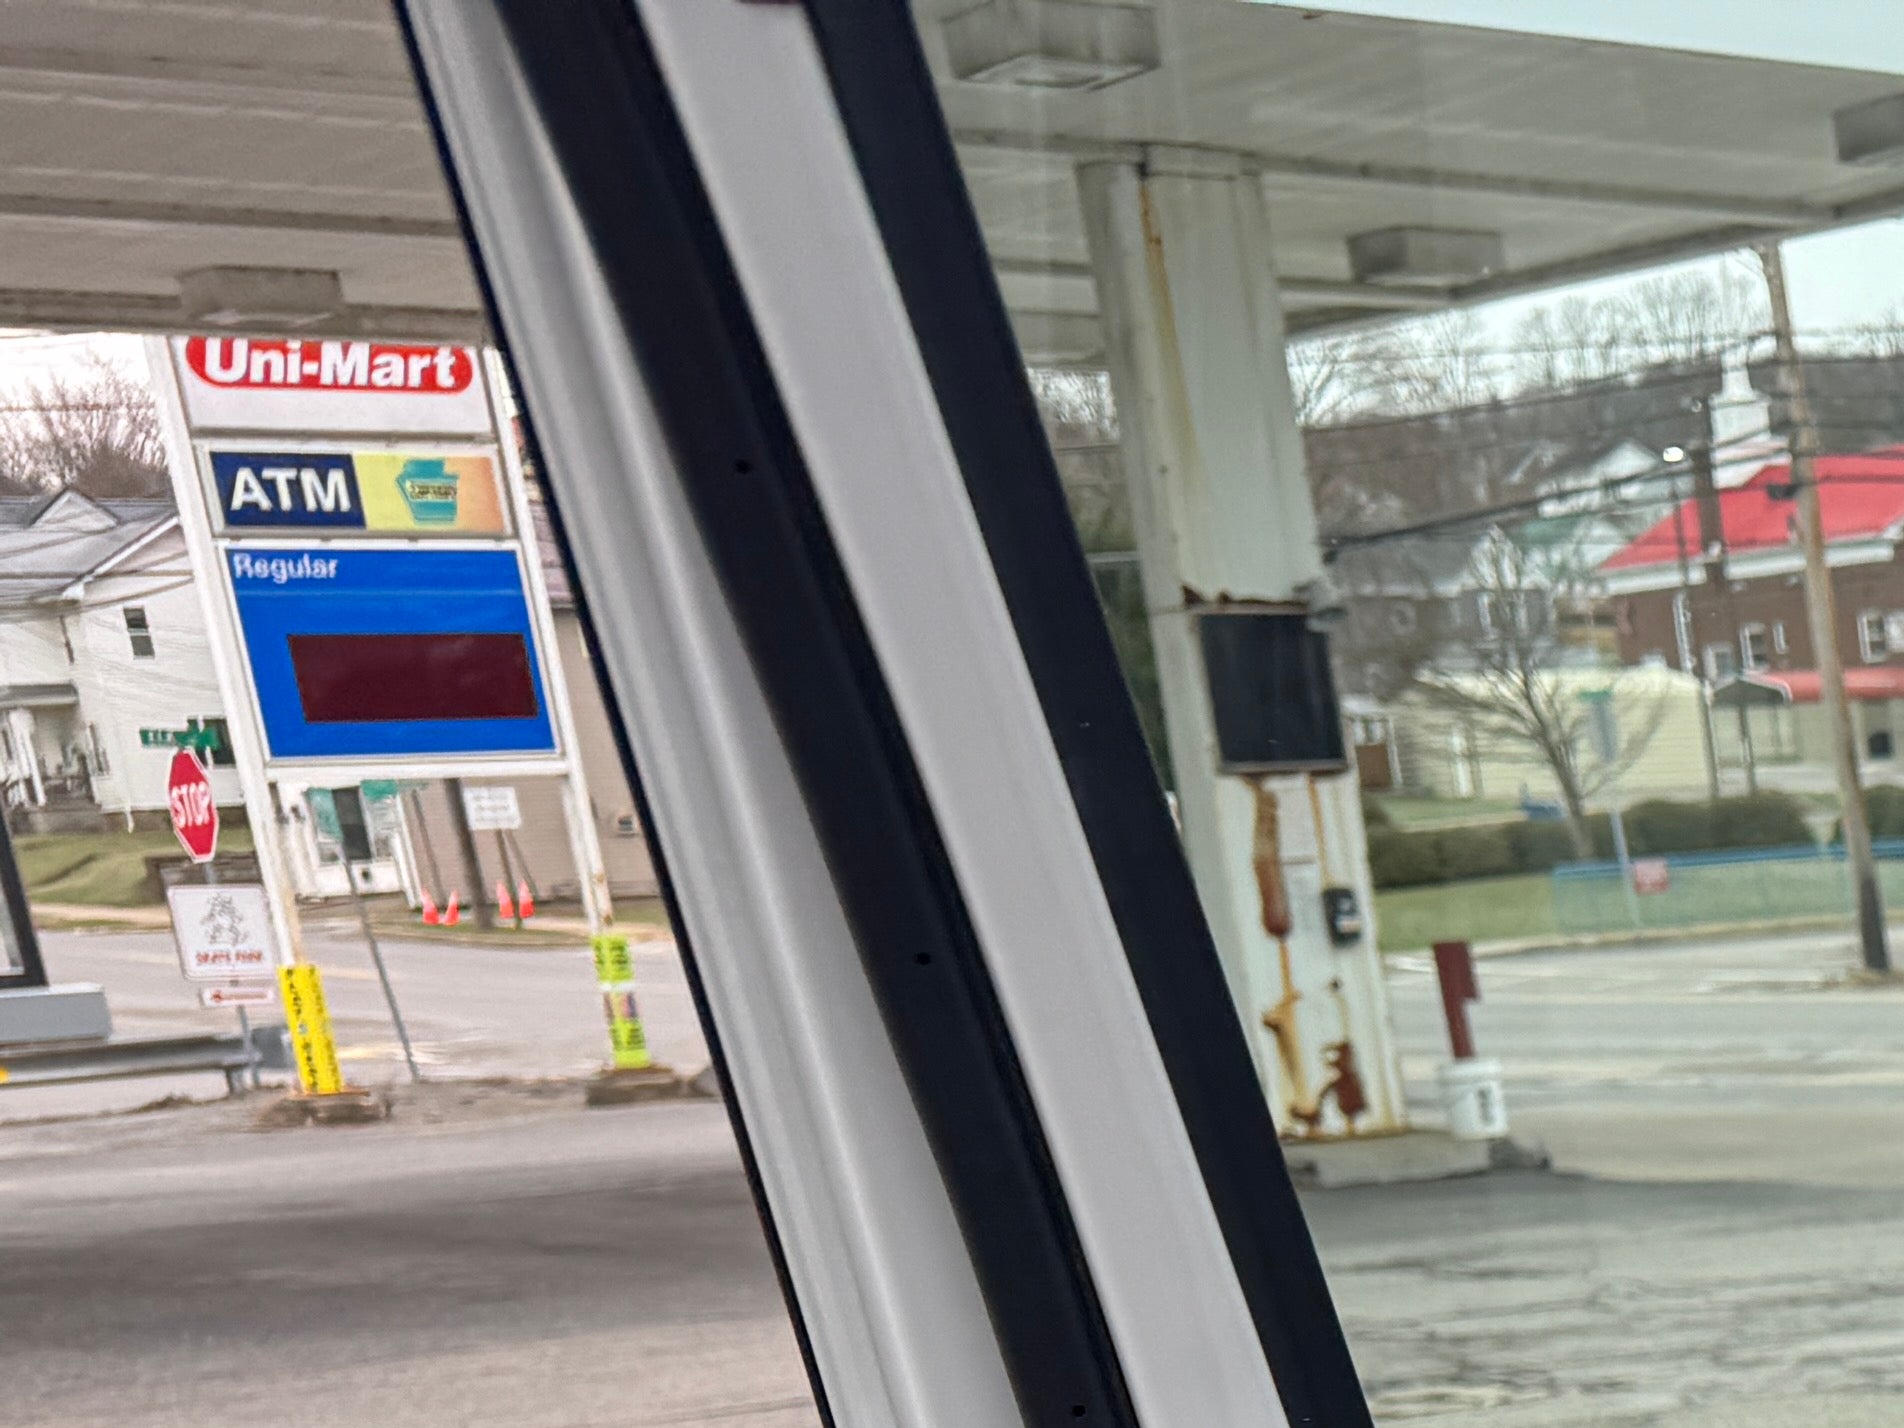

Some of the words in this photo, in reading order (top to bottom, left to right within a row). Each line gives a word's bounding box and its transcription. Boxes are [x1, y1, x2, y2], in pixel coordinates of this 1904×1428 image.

[203, 337, 456, 388] Uni-Mart
[230, 466, 351, 513] ATM
[233, 553, 338, 583] Regular
[171, 781, 211, 829] STOP
